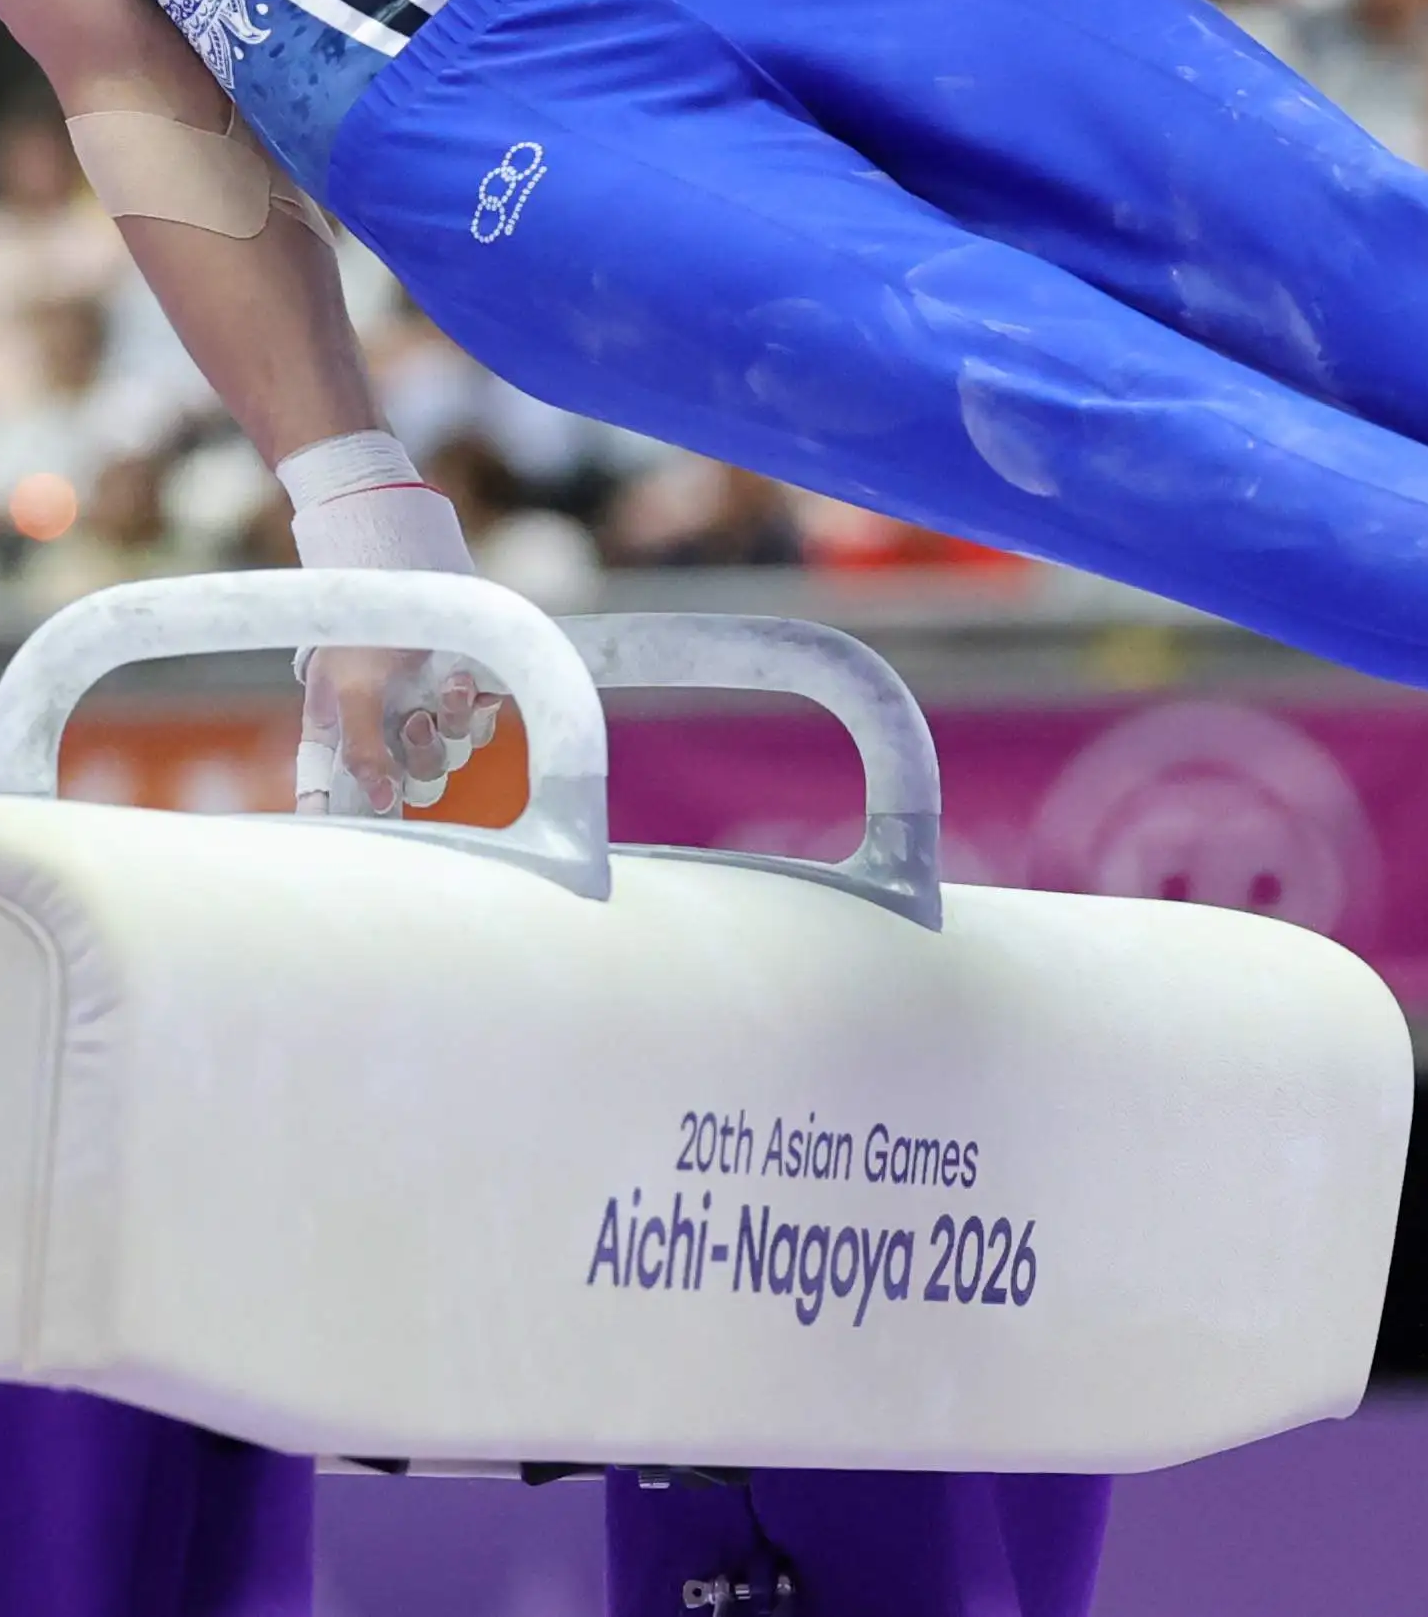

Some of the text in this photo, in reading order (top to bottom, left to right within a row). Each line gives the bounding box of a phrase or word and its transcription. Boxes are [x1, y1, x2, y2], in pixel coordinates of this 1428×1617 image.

[676, 1109, 979, 1189] 20th Asian Games
[586, 1187, 1037, 1328] Aichi-Nagoya 2026
